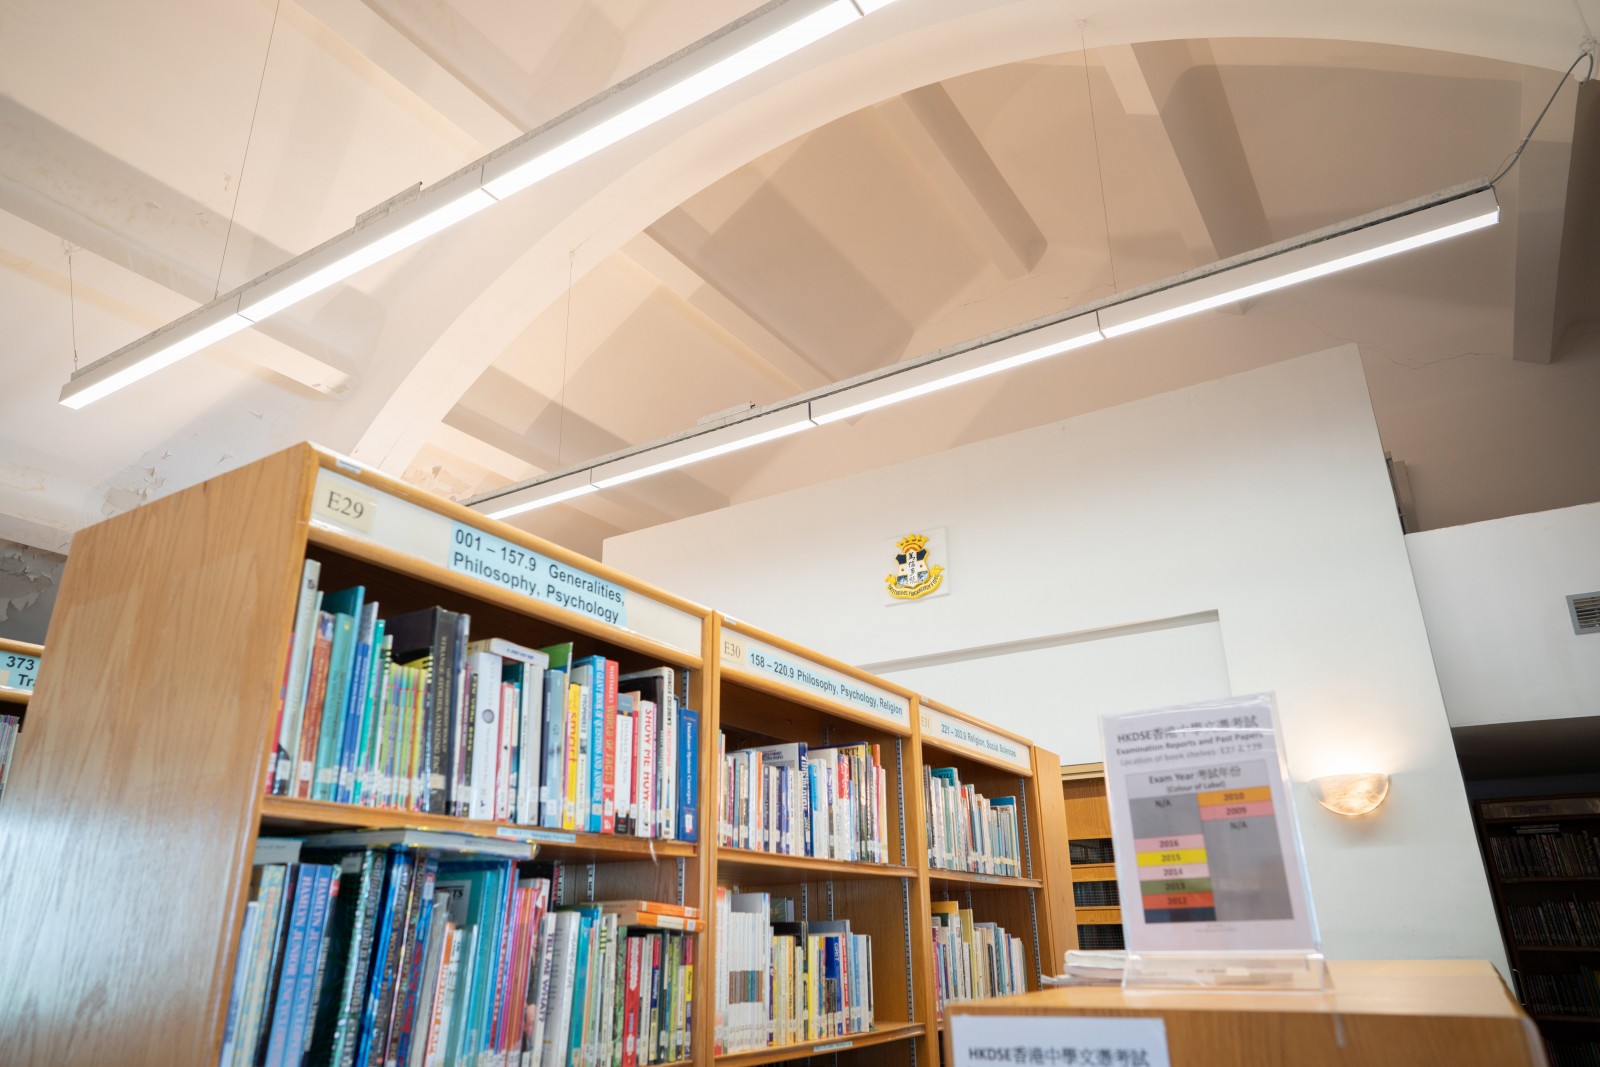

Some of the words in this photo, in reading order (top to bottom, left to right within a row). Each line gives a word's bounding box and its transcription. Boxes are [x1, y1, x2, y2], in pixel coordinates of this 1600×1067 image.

[326, 490, 366, 520] E29
[456, 529, 482, 552] 001
[501, 546, 537, 572] 157.9
[548, 564, 626, 607] Generalities,
[454, 551, 540, 597] Philosophy,
[546, 583, 620, 625] Psychology
[724, 640, 741, 659] E30
[6, 656, 34, 671] 373
[750, 652, 765, 668] 158
[773, 660, 794, 679] 220.9
[797, 669, 839, 695] Philosophy,
[840, 684, 879, 709] Psychology,
[879, 697, 903, 716] Religion
[595, 692, 604, 709] BOOK
[606, 705, 614, 738] WORLD
[644, 708, 652, 745] SHOW
[568, 712, 577, 762] smart
[606, 739, 614, 750] OF
[941, 724, 949, 734] 221
[967, 732, 986, 748] Religion,
[987, 740, 998, 751] Social
[1000, 744, 1016, 757] Sciences
[1117, 744, 1163, 755] Examination
[1165, 738, 1196, 749] Reports
[1216, 735, 1232, 743] Past
[1235, 733, 1264, 742] Papers
[594, 754, 602, 769] AND
[604, 752, 614, 782] FACTS
[644, 749, 651, 768] ME
[1120, 757, 1152, 766] Location
[1155, 754, 1163, 762] of
[1149, 775, 1173, 784] Exam
[1175, 772, 1194, 781] Year
[1166, 784, 1193, 793] (Colour
[1224, 792, 1245, 801] 2010
[1155, 799, 1172, 808] N/A
[1226, 806, 1247, 815] 2009
[1230, 821, 1248, 830] N/A
[1159, 840, 1179, 848] 2016
[1163, 868, 1183, 876] 2014
[1166, 882, 1186, 891] 2013
[295, 876, 312, 927] HAMLYN
[311, 877, 328, 927] HAMLYN
[1168, 897, 1187, 906] 2012
[287, 928, 303, 974] JUNIOR
[303, 929, 320, 975] JUNIOR
[545, 932, 555, 956] TELL
[542, 958, 552, 977] ME
[537, 980, 549, 1023] WHAT?
